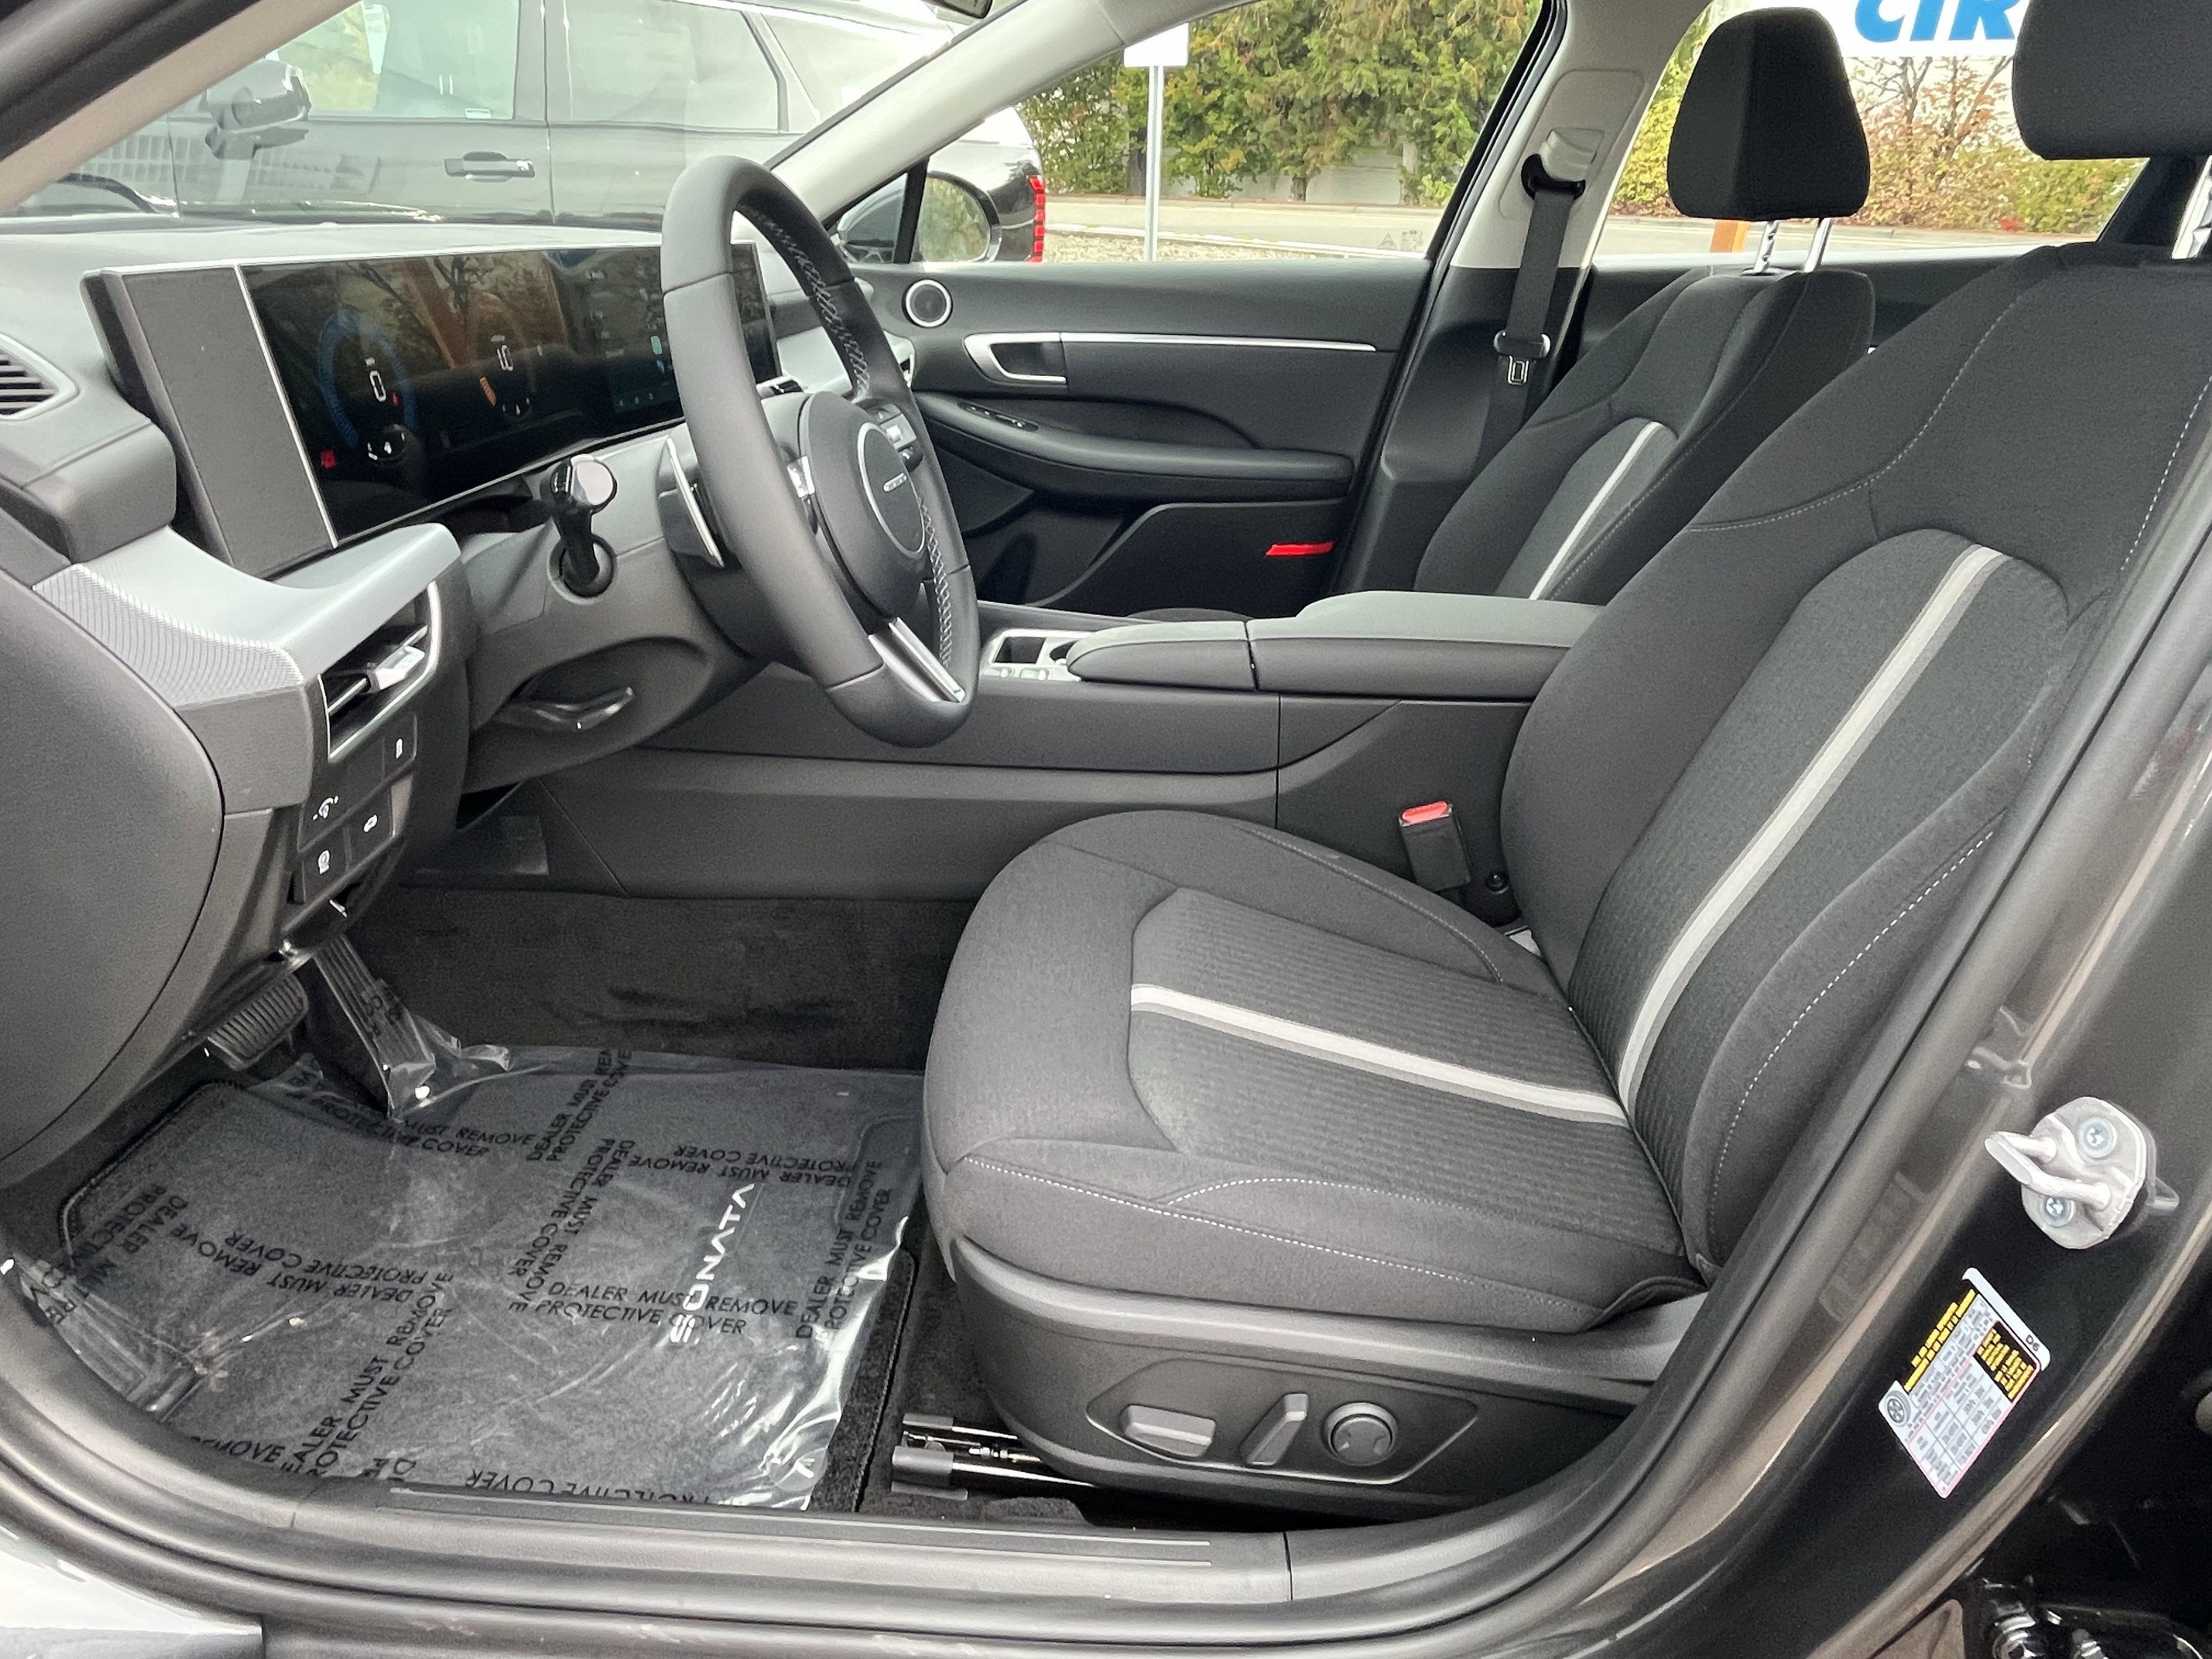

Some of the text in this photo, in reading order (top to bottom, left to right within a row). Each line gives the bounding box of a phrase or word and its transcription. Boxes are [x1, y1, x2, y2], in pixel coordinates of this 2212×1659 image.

[603, 1048, 632, 1087] COVE
[421, 1137, 490, 1156] COVER
[455, 1127, 535, 1146] REMOVE
[674, 1144, 742, 1163] COVER
[627, 1155, 851, 1188] DEALER MUST REMOVE
[170, 1222, 414, 1304] DEALER MUST REMOVE
[224, 1231, 428, 1285] PROTECTIVE COVER
[507, 1222, 558, 1277] COVER
[670, 1183, 755, 1344] SONATA
[825, 1228, 854, 1266] MUST
[509, 1243, 568, 1312] REMOVE
[535, 1299, 661, 1324] PROTECTIVE
[548, 1281, 628, 1301] DEALER
[705, 1295, 798, 1316] REMOVE
[340, 1355, 388, 1404] MUST
